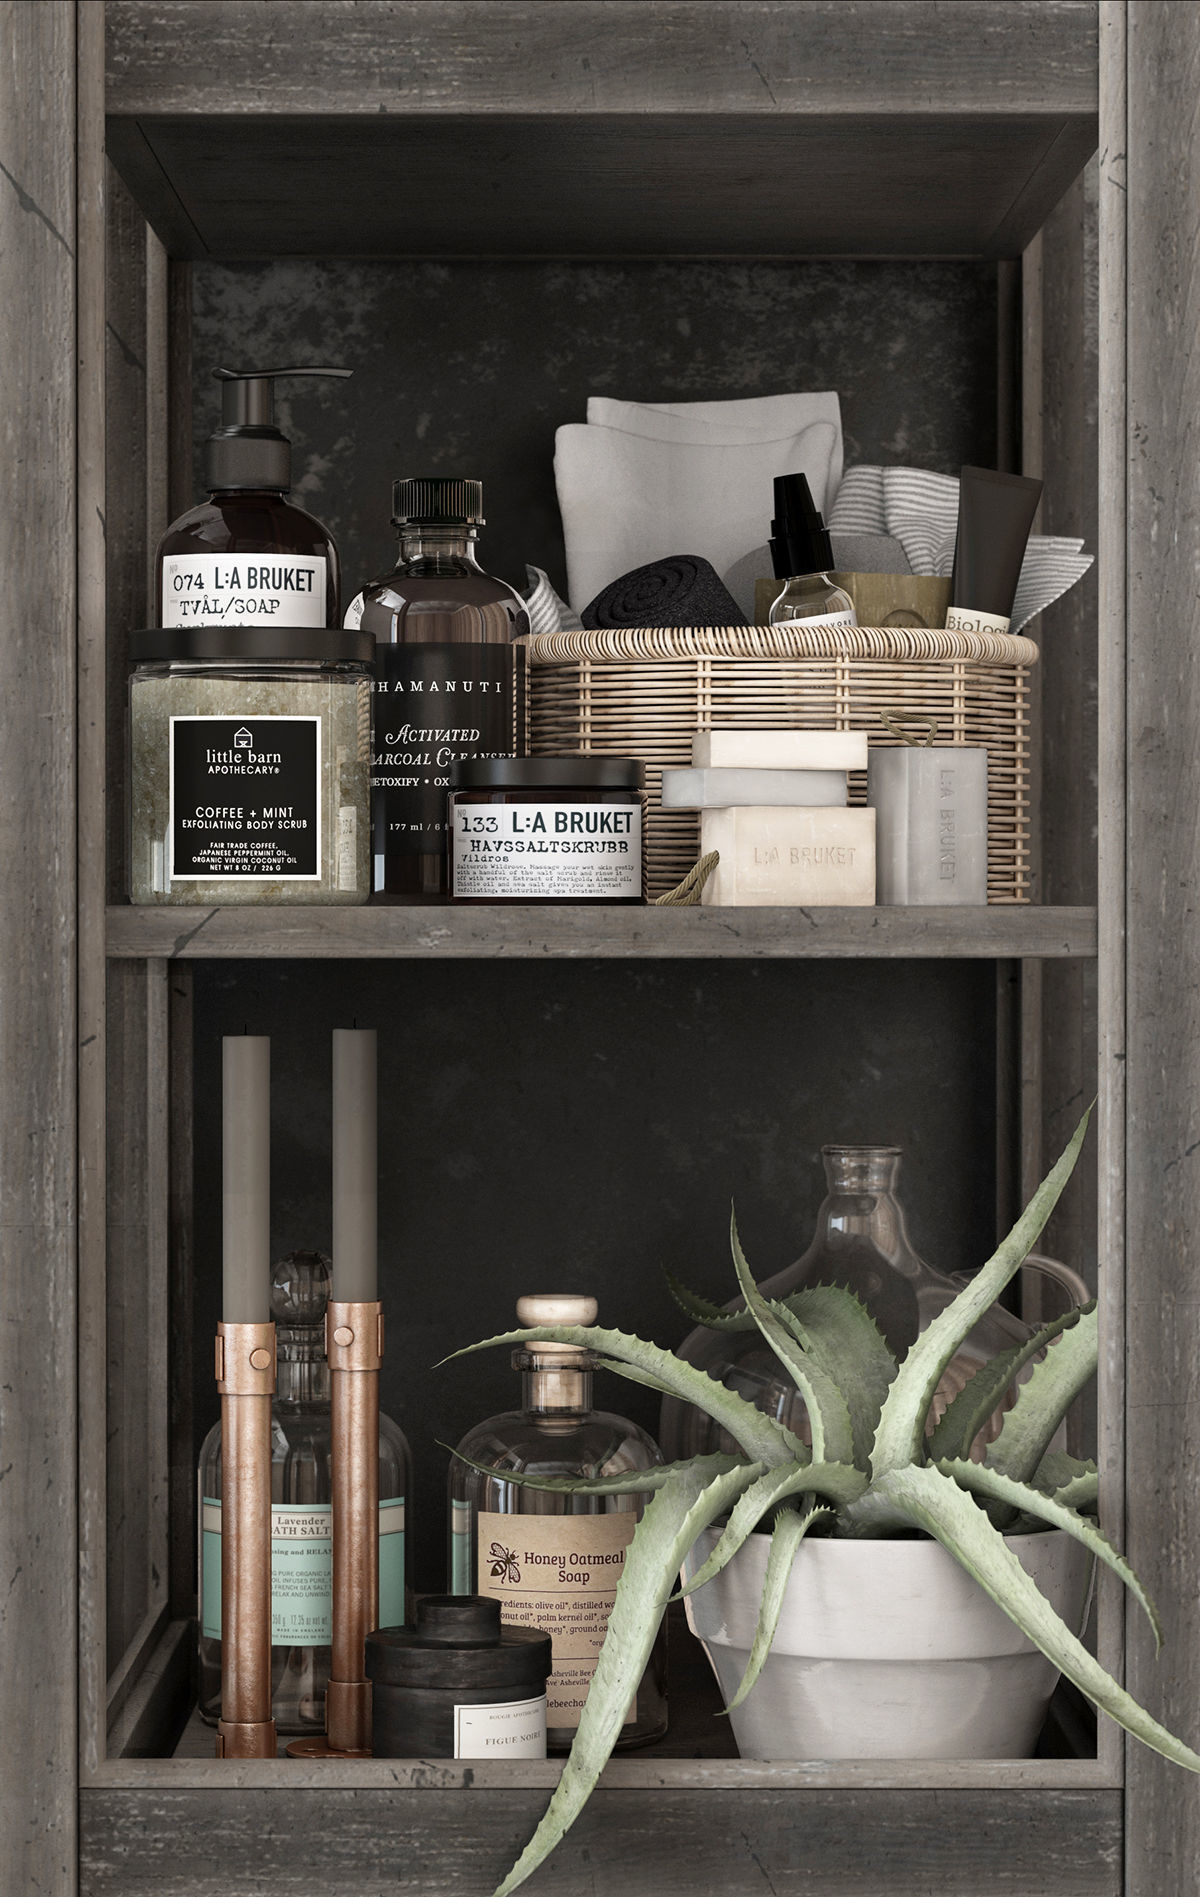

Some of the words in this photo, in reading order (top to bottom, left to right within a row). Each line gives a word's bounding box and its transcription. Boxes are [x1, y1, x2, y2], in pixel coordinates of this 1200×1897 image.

[174, 573, 204, 591] 074
[215, 566, 241, 590] L:A
[248, 566, 315, 592] BRUKET
[179, 595, 280, 619] TVÅL/SOAP
[206, 749, 242, 764] little
[248, 749, 282, 764] barn
[196, 806, 244, 819] COFFEE
[263, 806, 294, 818] MINT
[182, 820, 242, 830] EXFOLIATING
[247, 820, 274, 830] BODY
[278, 819, 308, 829] SCRUB
[462, 817, 498, 832] 133
[513, 812, 546, 833] L:A
[555, 812, 633, 833] BRUKET
[470, 840, 628, 853] HAVSSALTSKRUBB
[940, 809, 956, 884] BRUKET
[790, 846, 857, 866] BRUKET
[278, 1516, 326, 1525] Lavender
[272, 1526, 297, 1535] ATH
[524, 1552, 566, 1568] Honey
[569, 1550, 624, 1565] Oatmeal
[558, 1570, 590, 1585] Soap
[535, 1600, 554, 1609] olive
[572, 1600, 603, 1609] distilled
[537, 1613, 557, 1622] palm
[558, 1613, 582, 1621] kernel
[570, 1625, 598, 1634] ground
[485, 1736, 518, 1745] FIGUE
[520, 1731, 541, 1742] NOIRE
